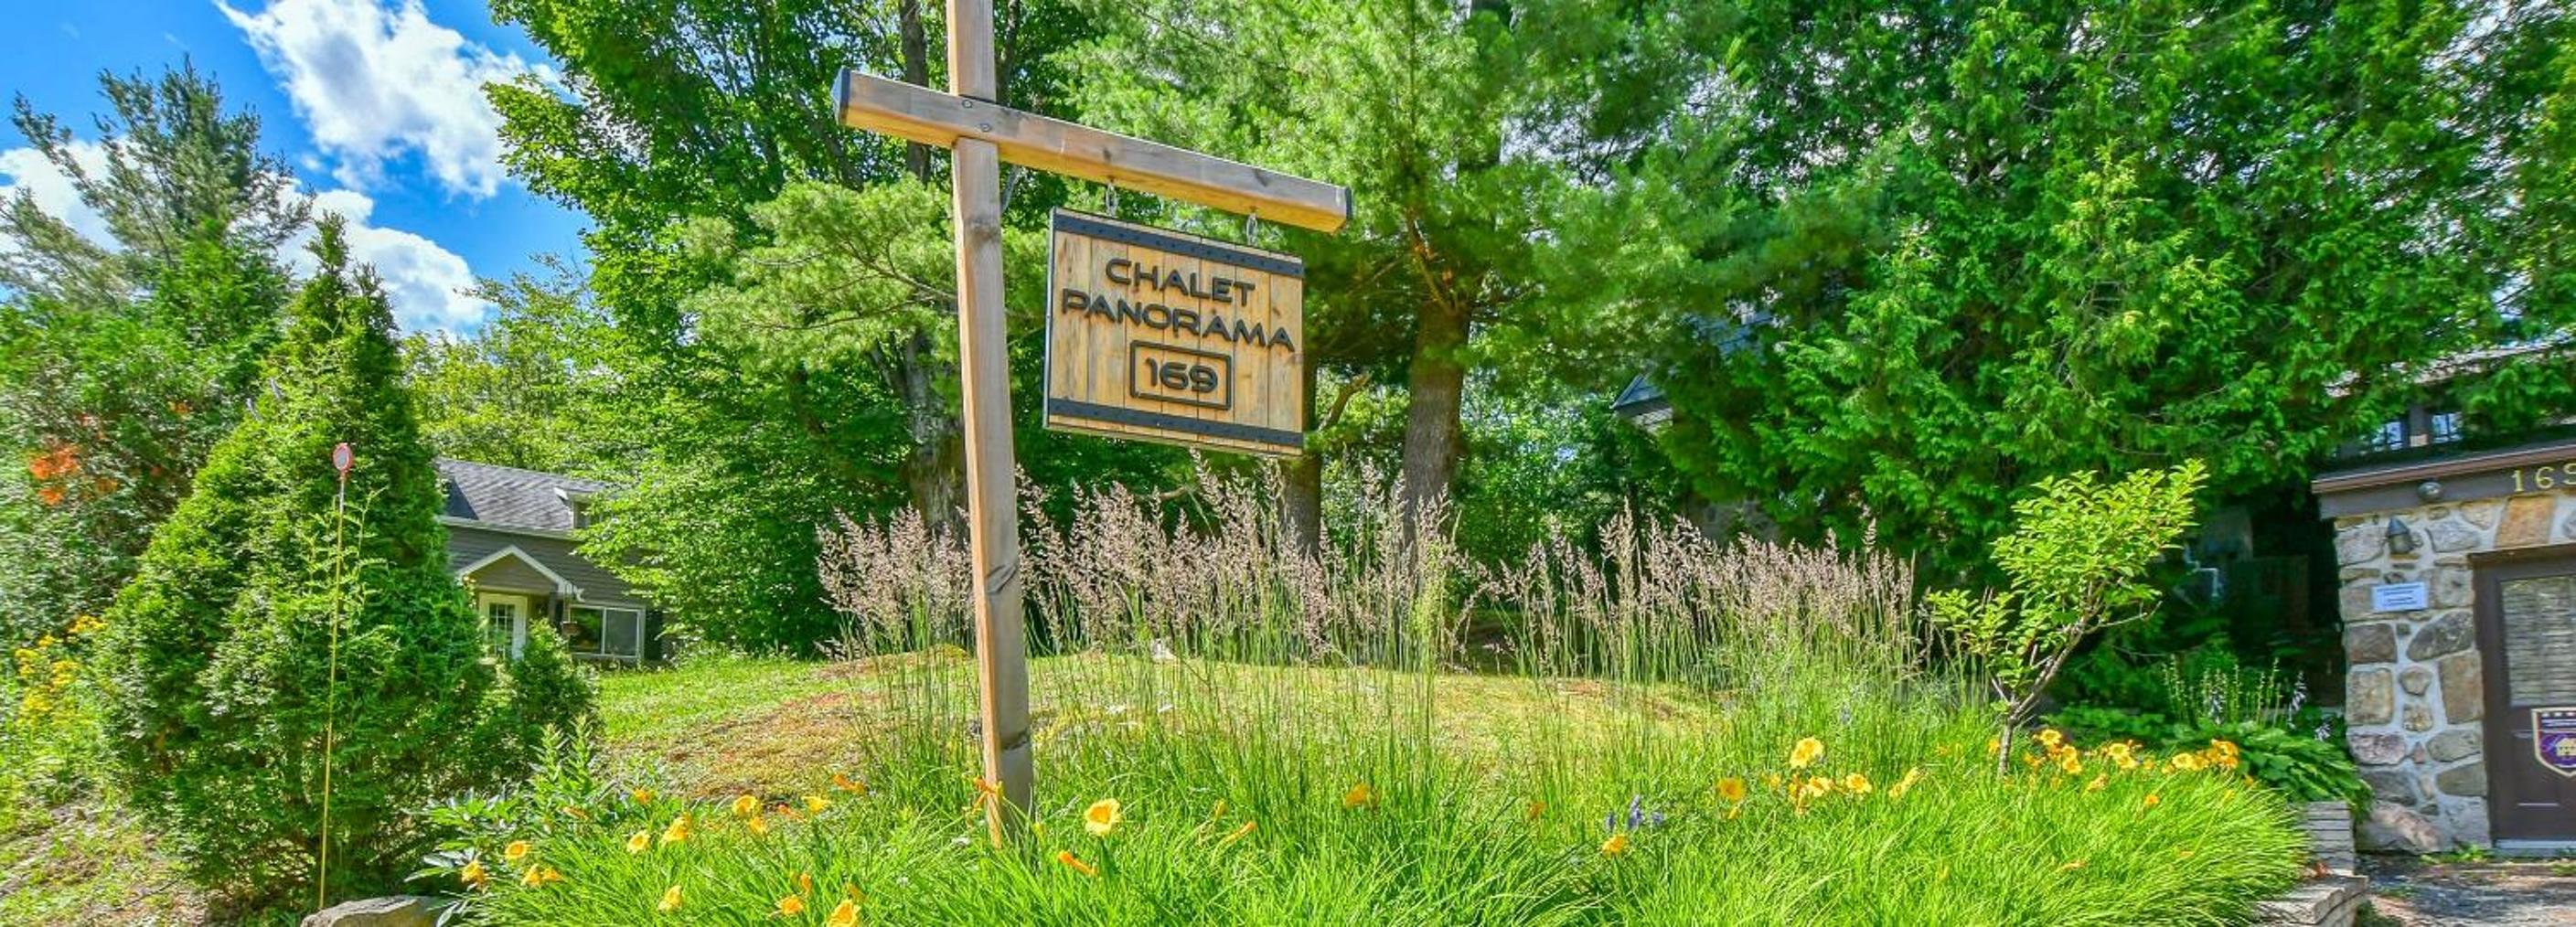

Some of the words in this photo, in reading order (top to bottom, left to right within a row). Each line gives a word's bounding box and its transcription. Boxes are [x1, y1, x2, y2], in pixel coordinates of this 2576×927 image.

[1106, 258, 1256, 306] CHALET
[1062, 288, 1295, 352] PANORAMA
[1146, 357, 1218, 393] 169
